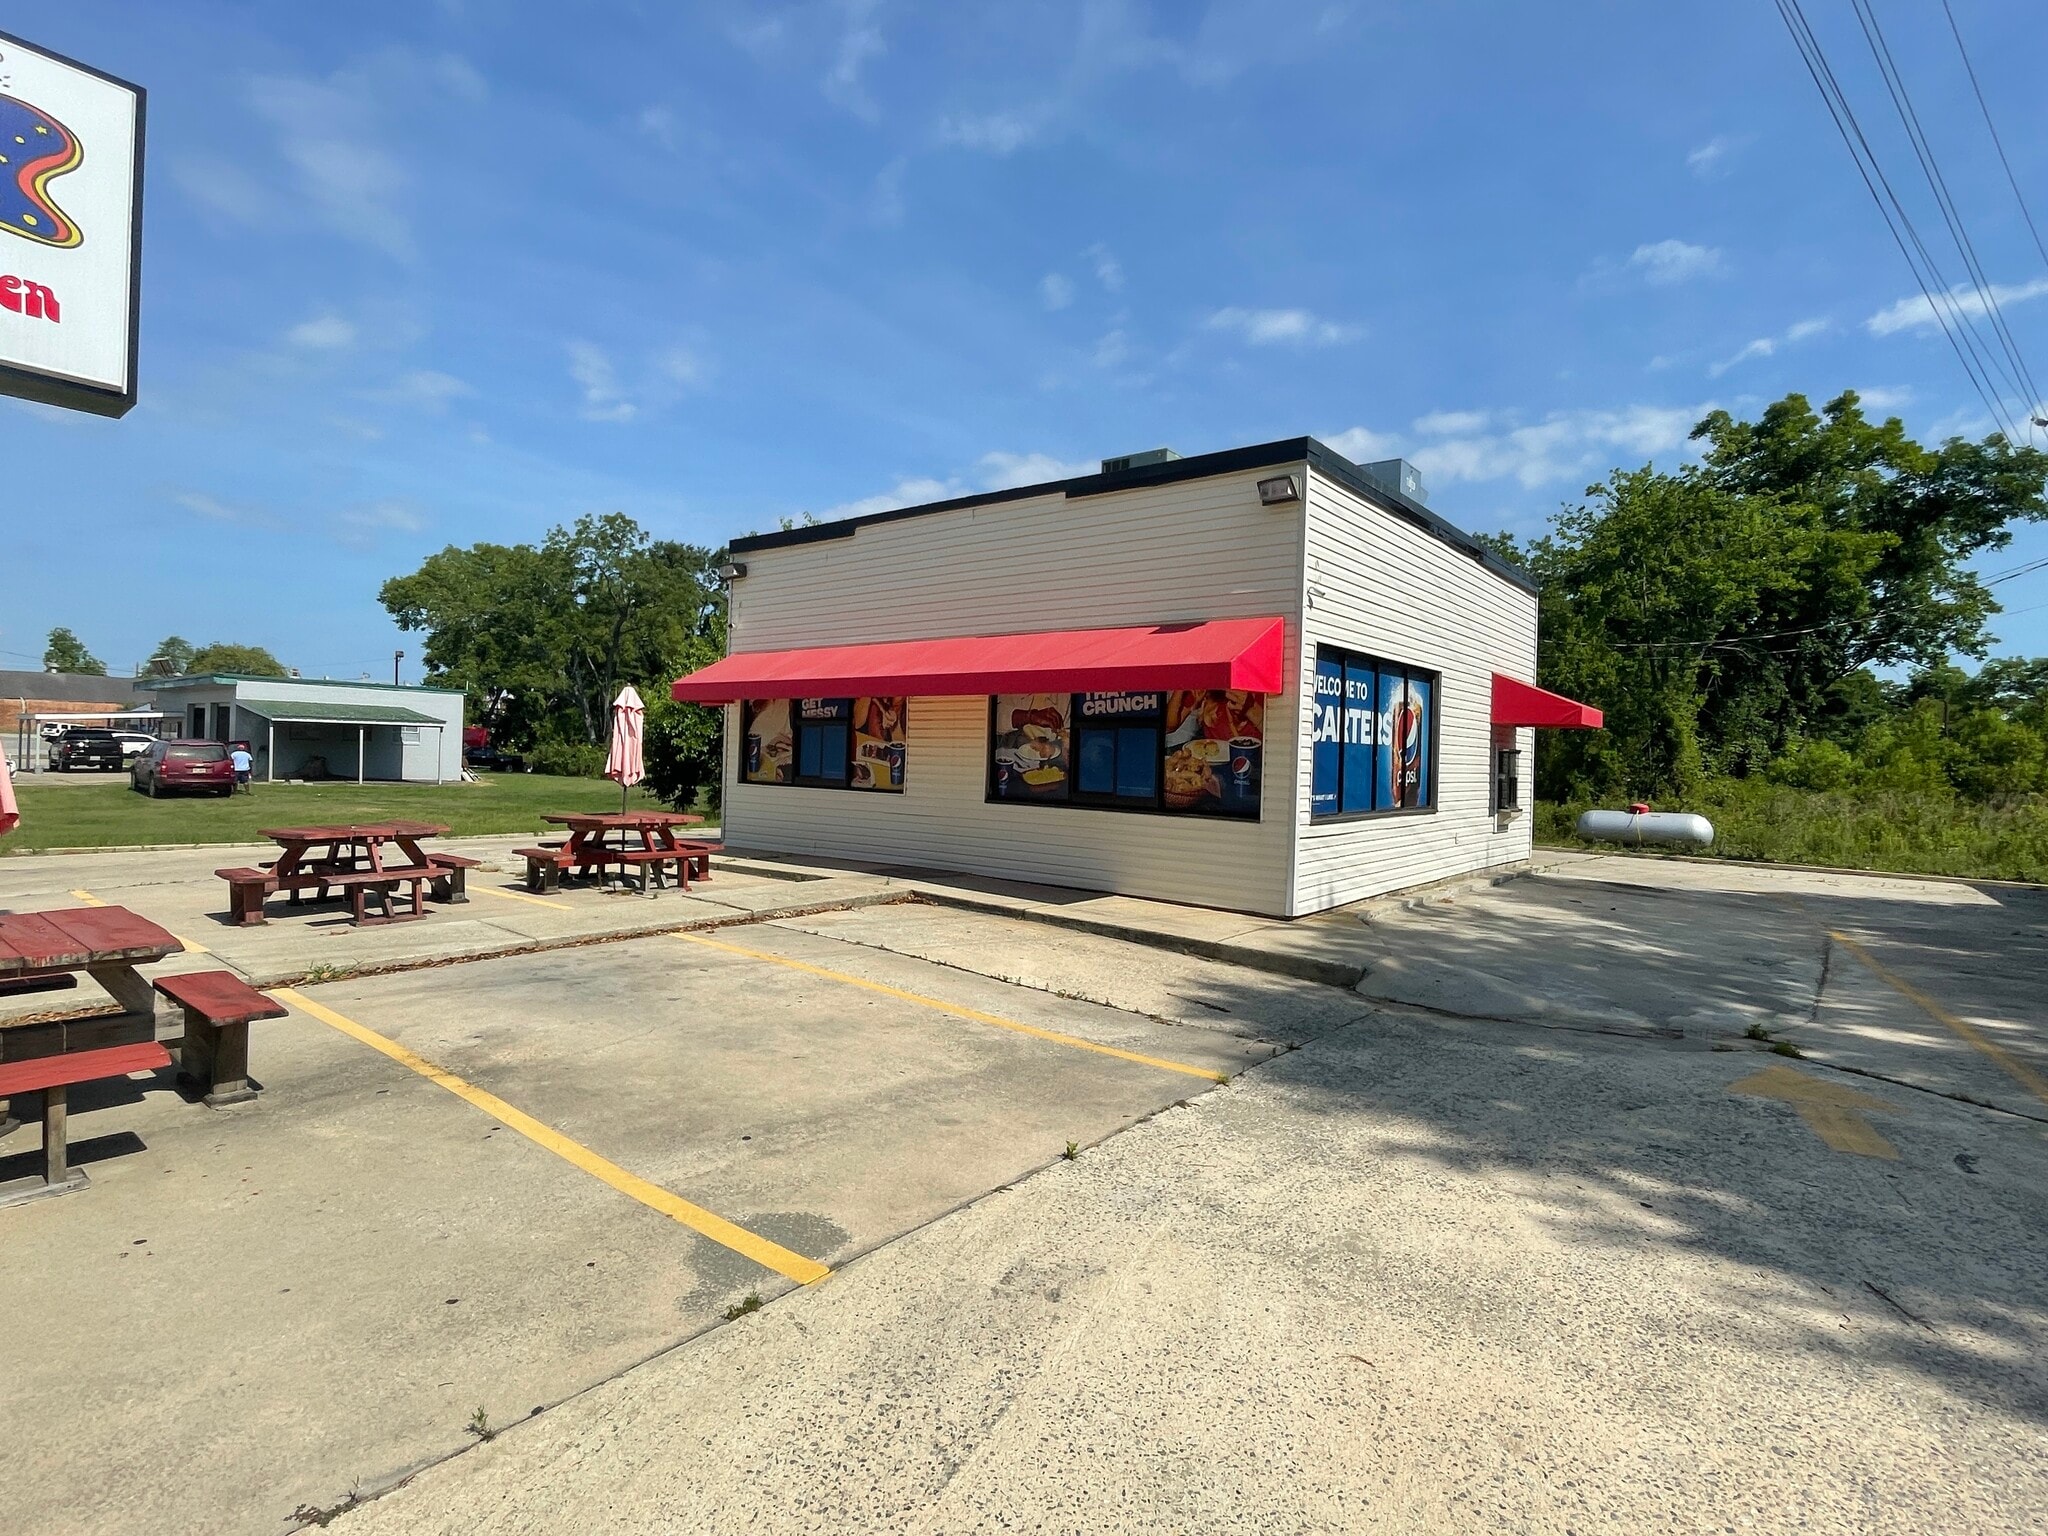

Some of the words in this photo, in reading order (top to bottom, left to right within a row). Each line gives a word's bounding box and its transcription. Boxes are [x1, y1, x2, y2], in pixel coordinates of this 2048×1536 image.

[1356, 682, 1368, 700] TO
[801, 698, 824, 710] GET
[801, 706, 839, 718] MESSY
[1082, 694, 1158, 716] CRUNCH
[1312, 703, 1393, 746] CARTERS
[1396, 768, 1417, 787] ppsi
